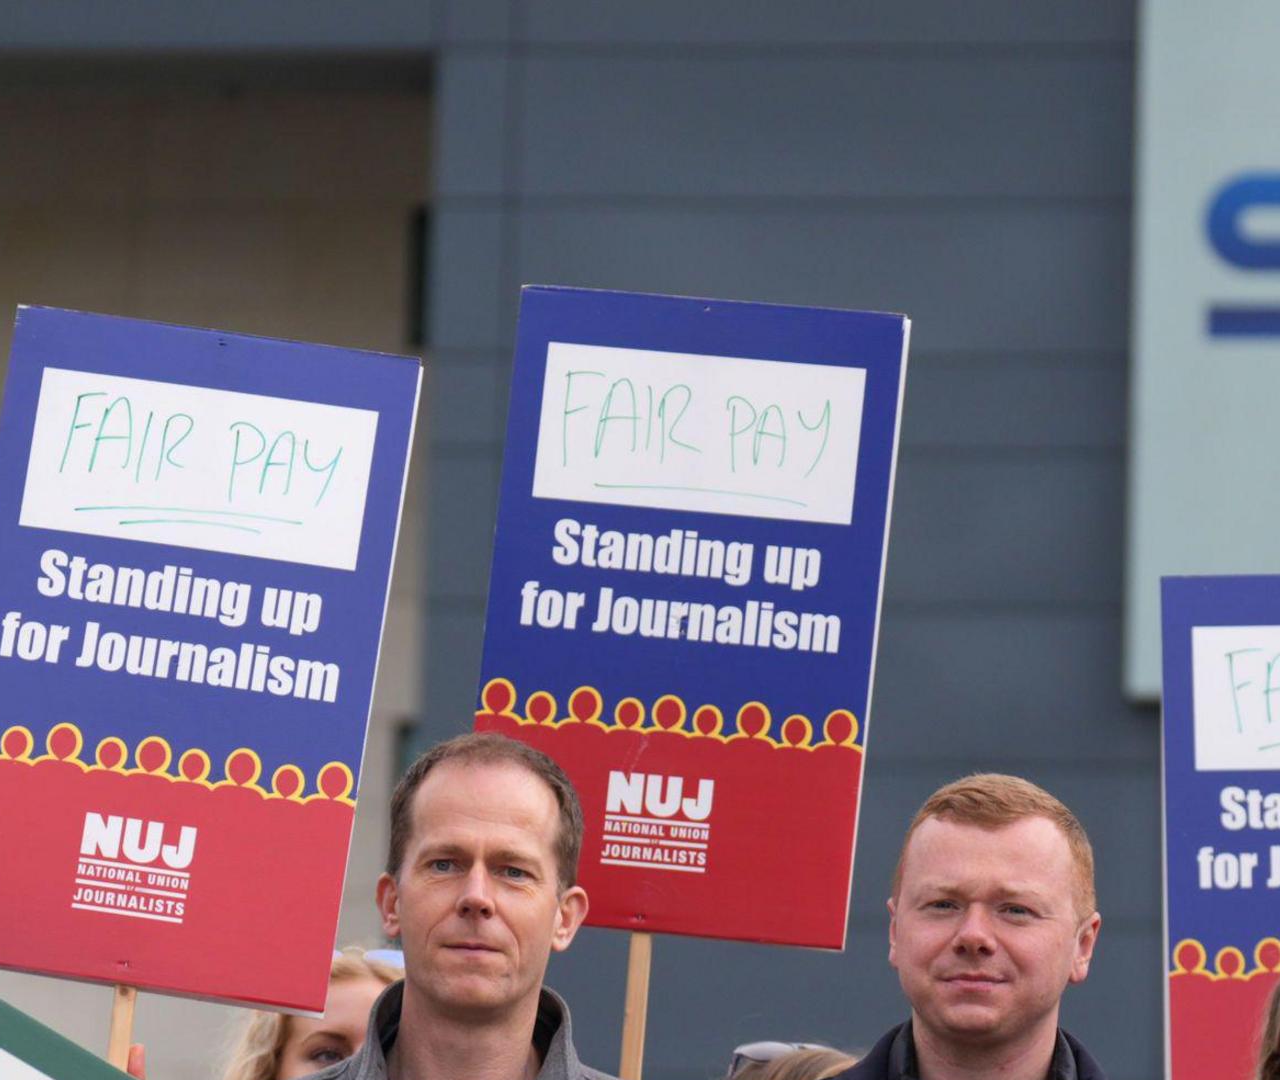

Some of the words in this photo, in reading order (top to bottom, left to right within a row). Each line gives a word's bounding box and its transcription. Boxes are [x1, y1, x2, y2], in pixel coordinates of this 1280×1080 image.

[60, 391, 194, 484] FAIR
[228, 421, 344, 507] PAY
[562, 369, 703, 468] FAIR
[726, 394, 832, 478] PAY
[552, 518, 755, 587] Standing
[764, 543, 822, 588] up
[37, 549, 251, 628] Standing
[261, 587, 322, 636] up
[520, 581, 586, 630] for
[592, 587, 842, 654] Journalism
[0, 611, 69, 664] for
[76, 621, 340, 703] Journalism
[606, 770, 715, 821] NUJ
[80, 811, 198, 869] NUJ
[601, 843, 707, 865] JOURNALISTS
[604, 821, 665, 836] NATIONAL
[670, 826, 710, 840] UNION
[77, 863, 142, 883] NATIONAL
[147, 873, 190, 890] UNION
[1197, 847, 1258, 889] for
[73, 887, 185, 915] JOURNALISTS
